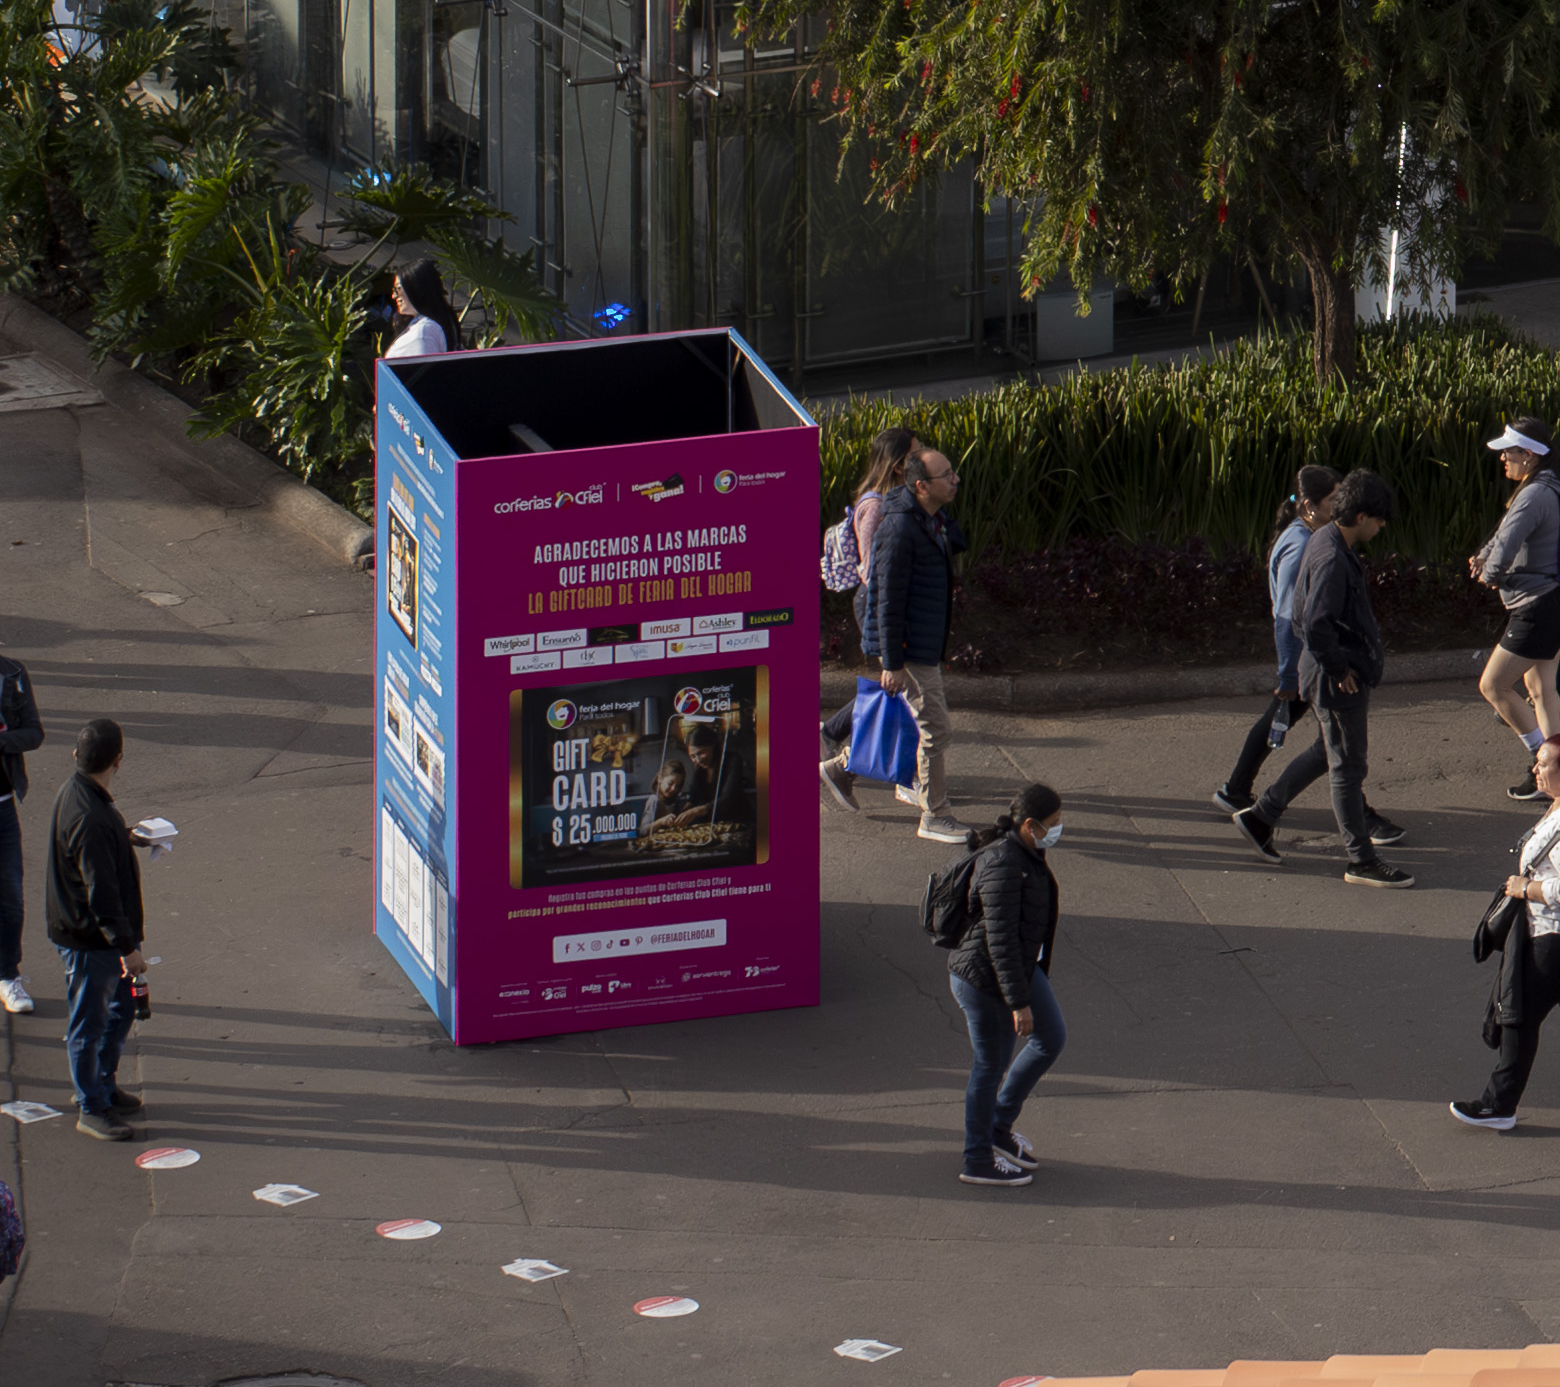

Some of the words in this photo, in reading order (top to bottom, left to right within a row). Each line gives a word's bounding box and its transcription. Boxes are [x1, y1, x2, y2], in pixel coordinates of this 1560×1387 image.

[533, 534, 639, 564] AGRADECEMOS
[643, 533, 652, 553] A
[657, 530, 682, 551] LAS
[687, 524, 747, 548] MARCAS
[559, 564, 587, 587] QUE
[590, 557, 659, 582] HICIERON
[663, 551, 722, 575] POSIBLE
[550, 584, 612, 613] GIFTCARD
[708, 617, 736, 630] Ashley
[553, 737, 590, 772] GIFT
[552, 769, 627, 812] CARD
[552, 816, 562, 847] $
[569, 812, 637, 845] 25.000.000
